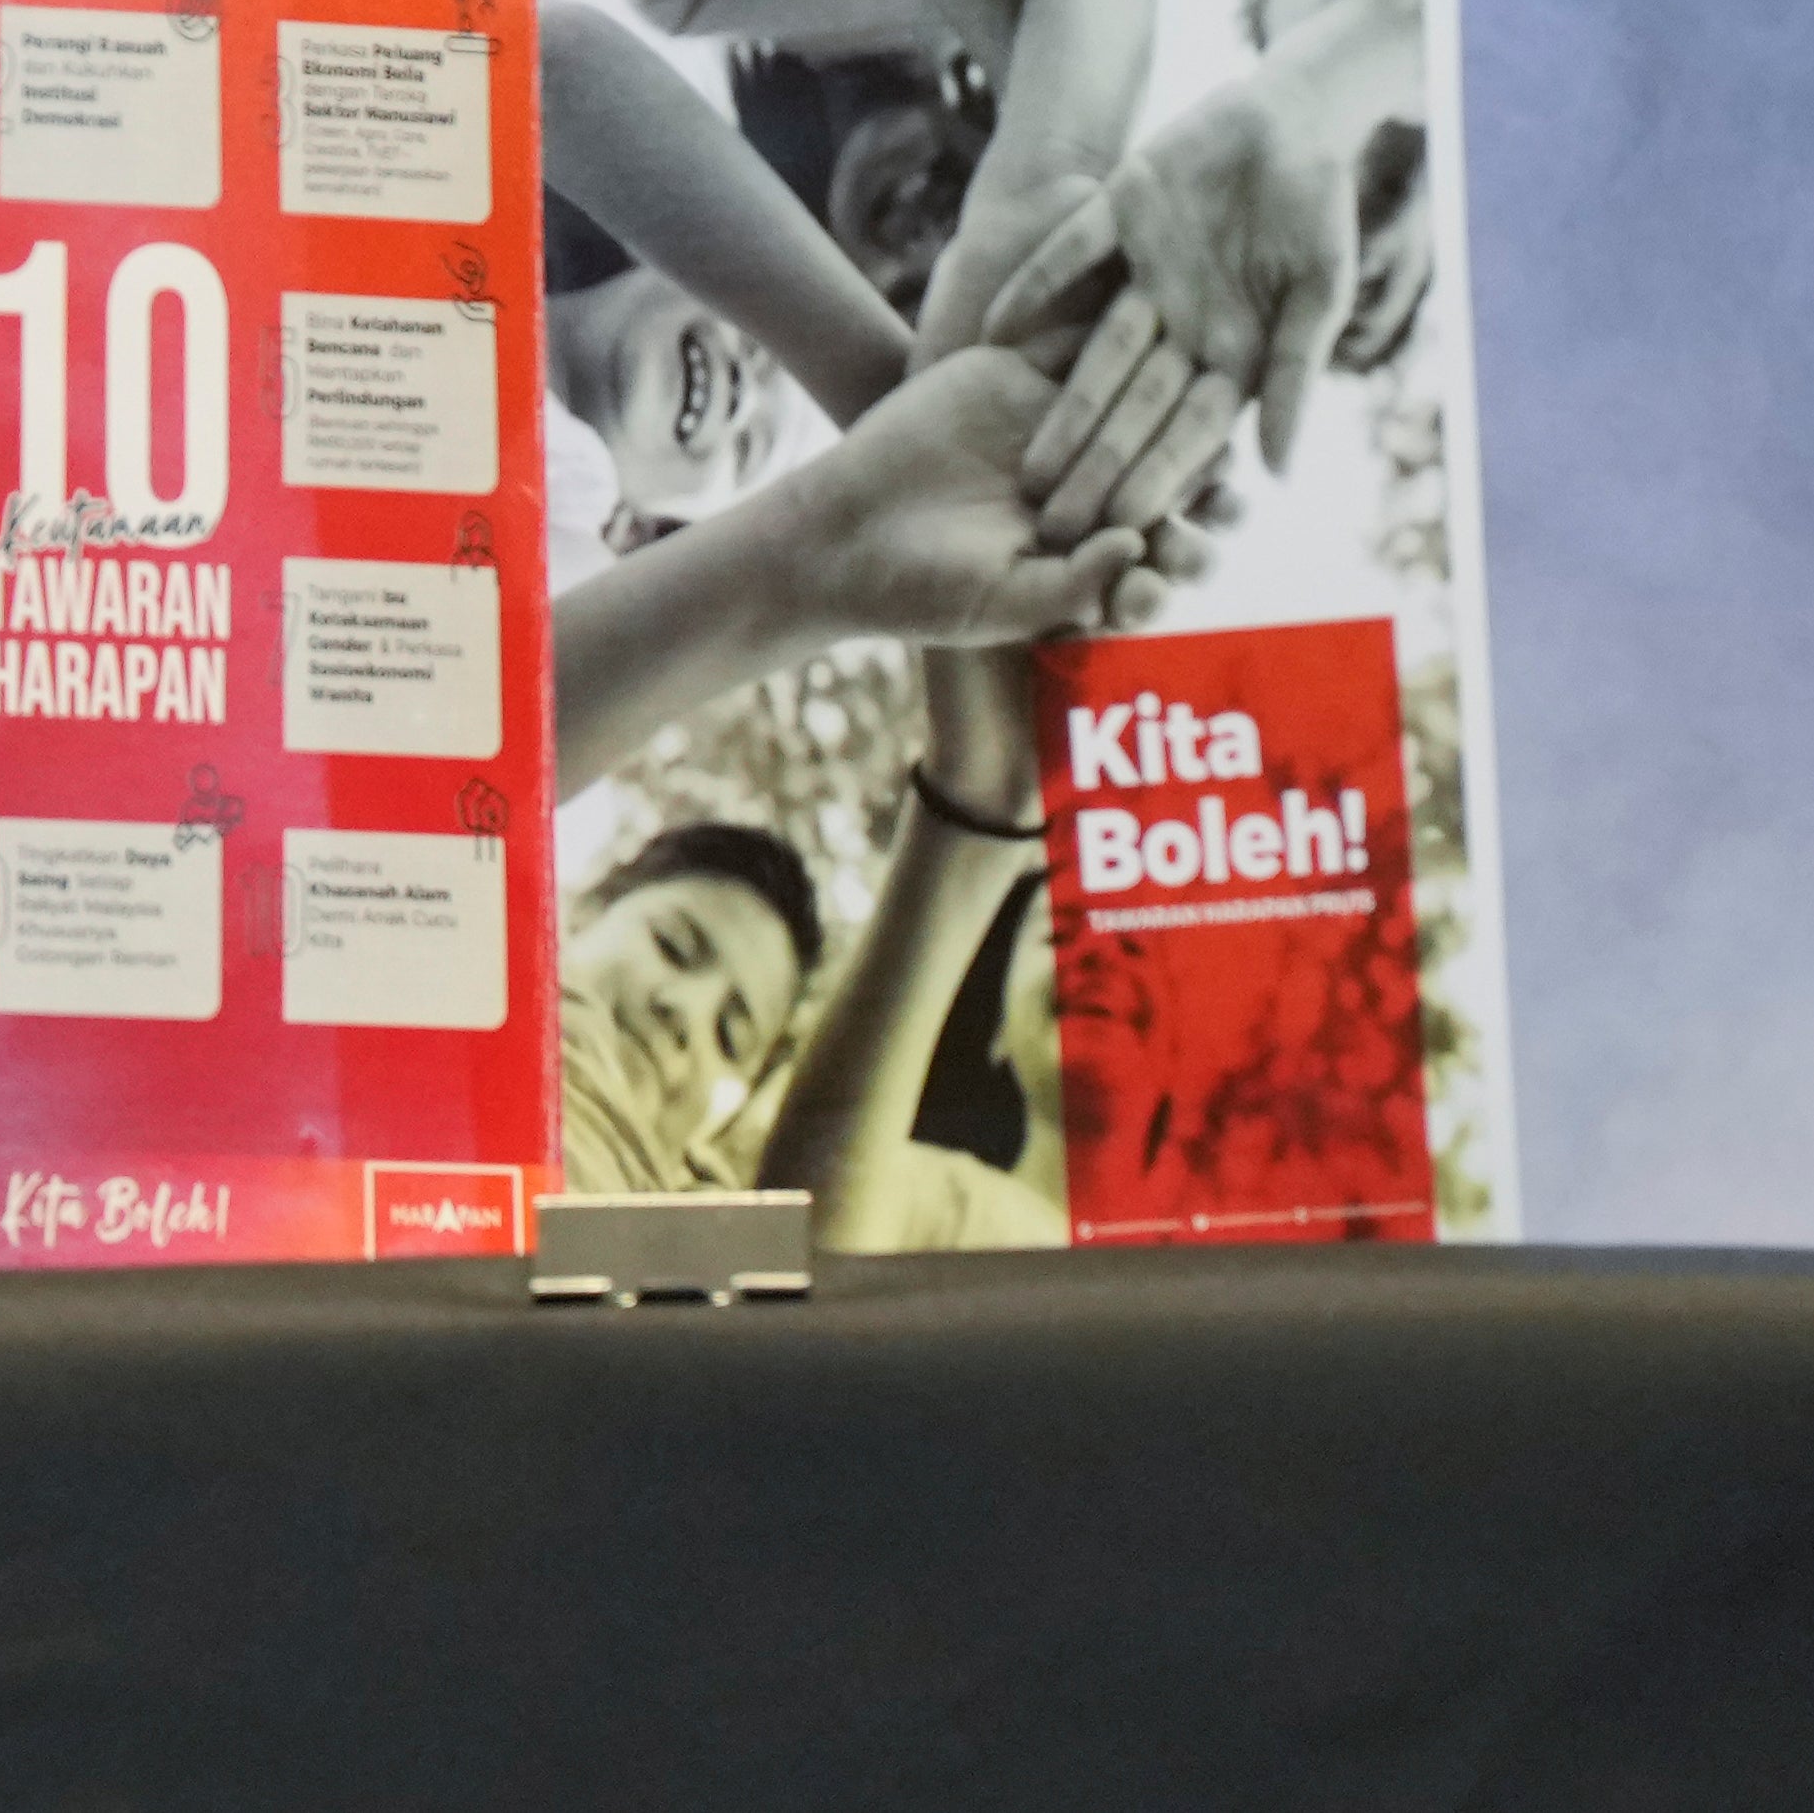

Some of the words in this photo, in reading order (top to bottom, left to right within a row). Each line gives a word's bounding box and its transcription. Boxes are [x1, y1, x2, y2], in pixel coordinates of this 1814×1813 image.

[1067, 691, 1263, 792] Kita
[1076, 787, 1370, 894] Boleh!
[0, 1171, 87, 1250] Kita
